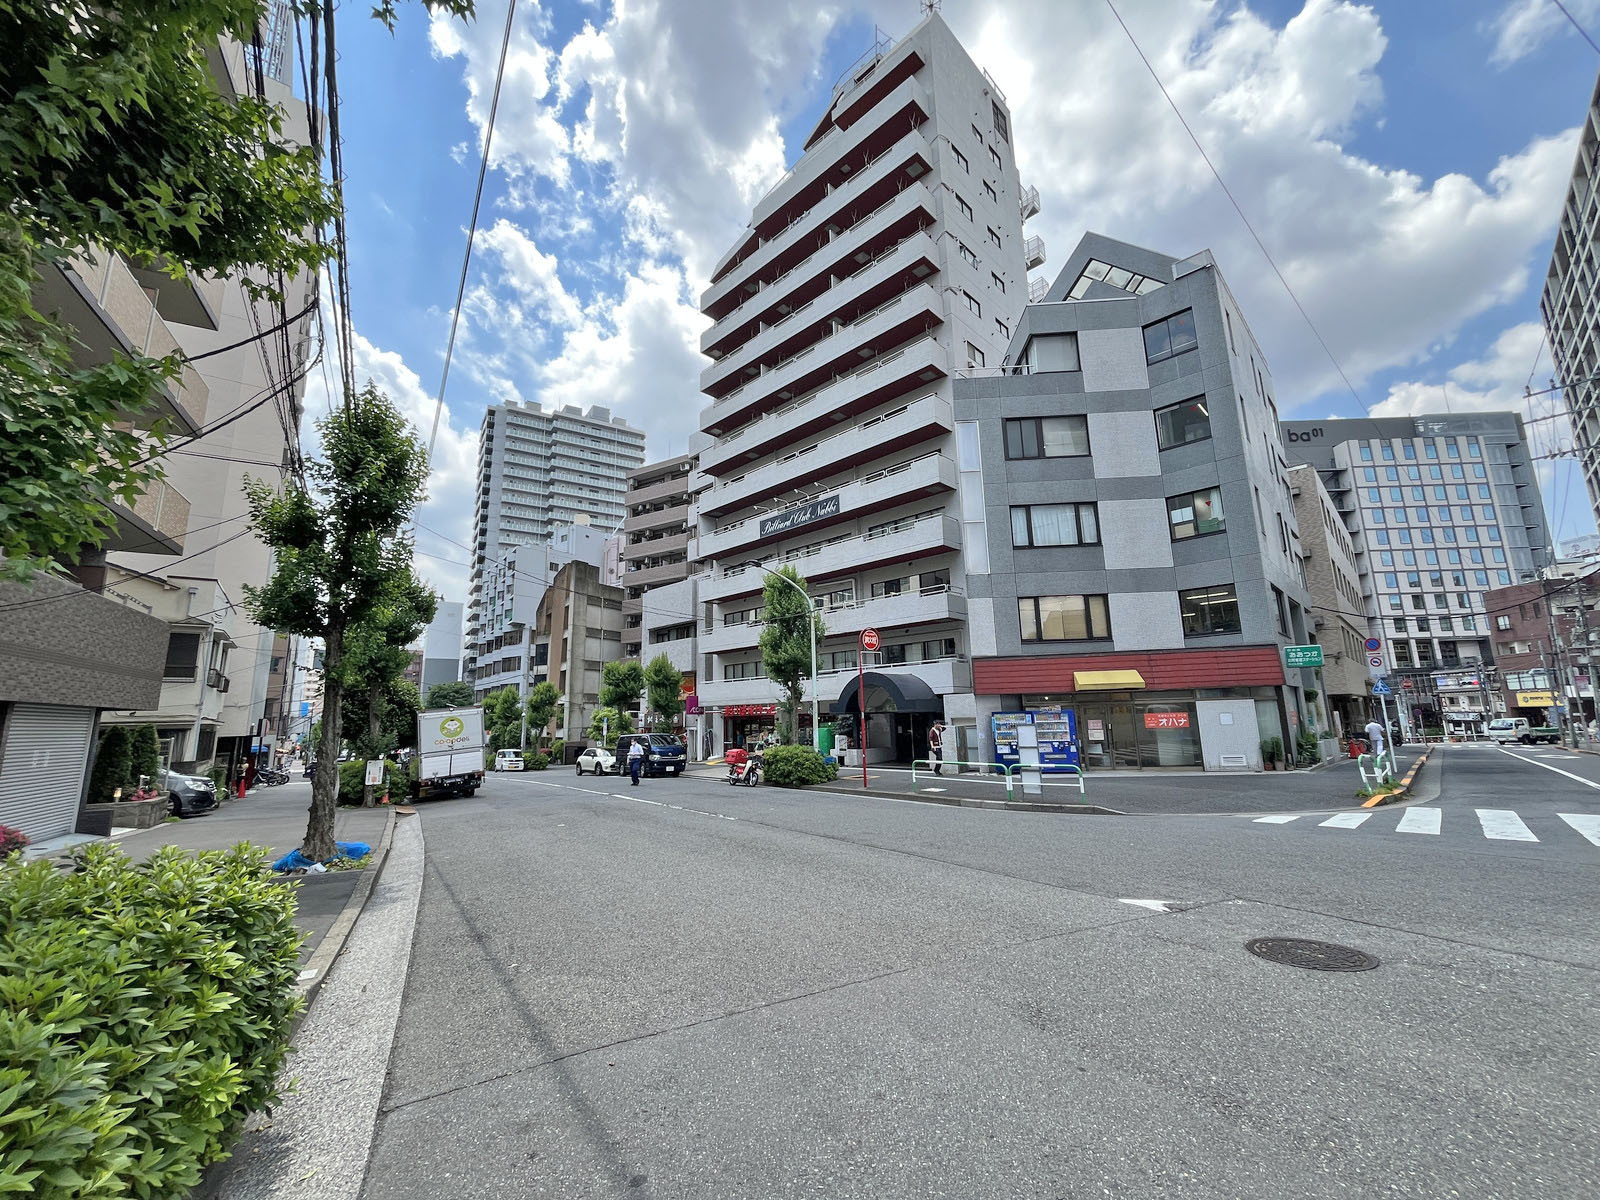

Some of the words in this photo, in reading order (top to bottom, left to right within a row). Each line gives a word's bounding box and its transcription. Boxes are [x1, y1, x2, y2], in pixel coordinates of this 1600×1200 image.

[1287, 428, 1324, 442] ba01
[761, 513, 794, 535] Billiard
[793, 507, 812, 524] Club
[1158, 718, 1187, 726] オハナ
